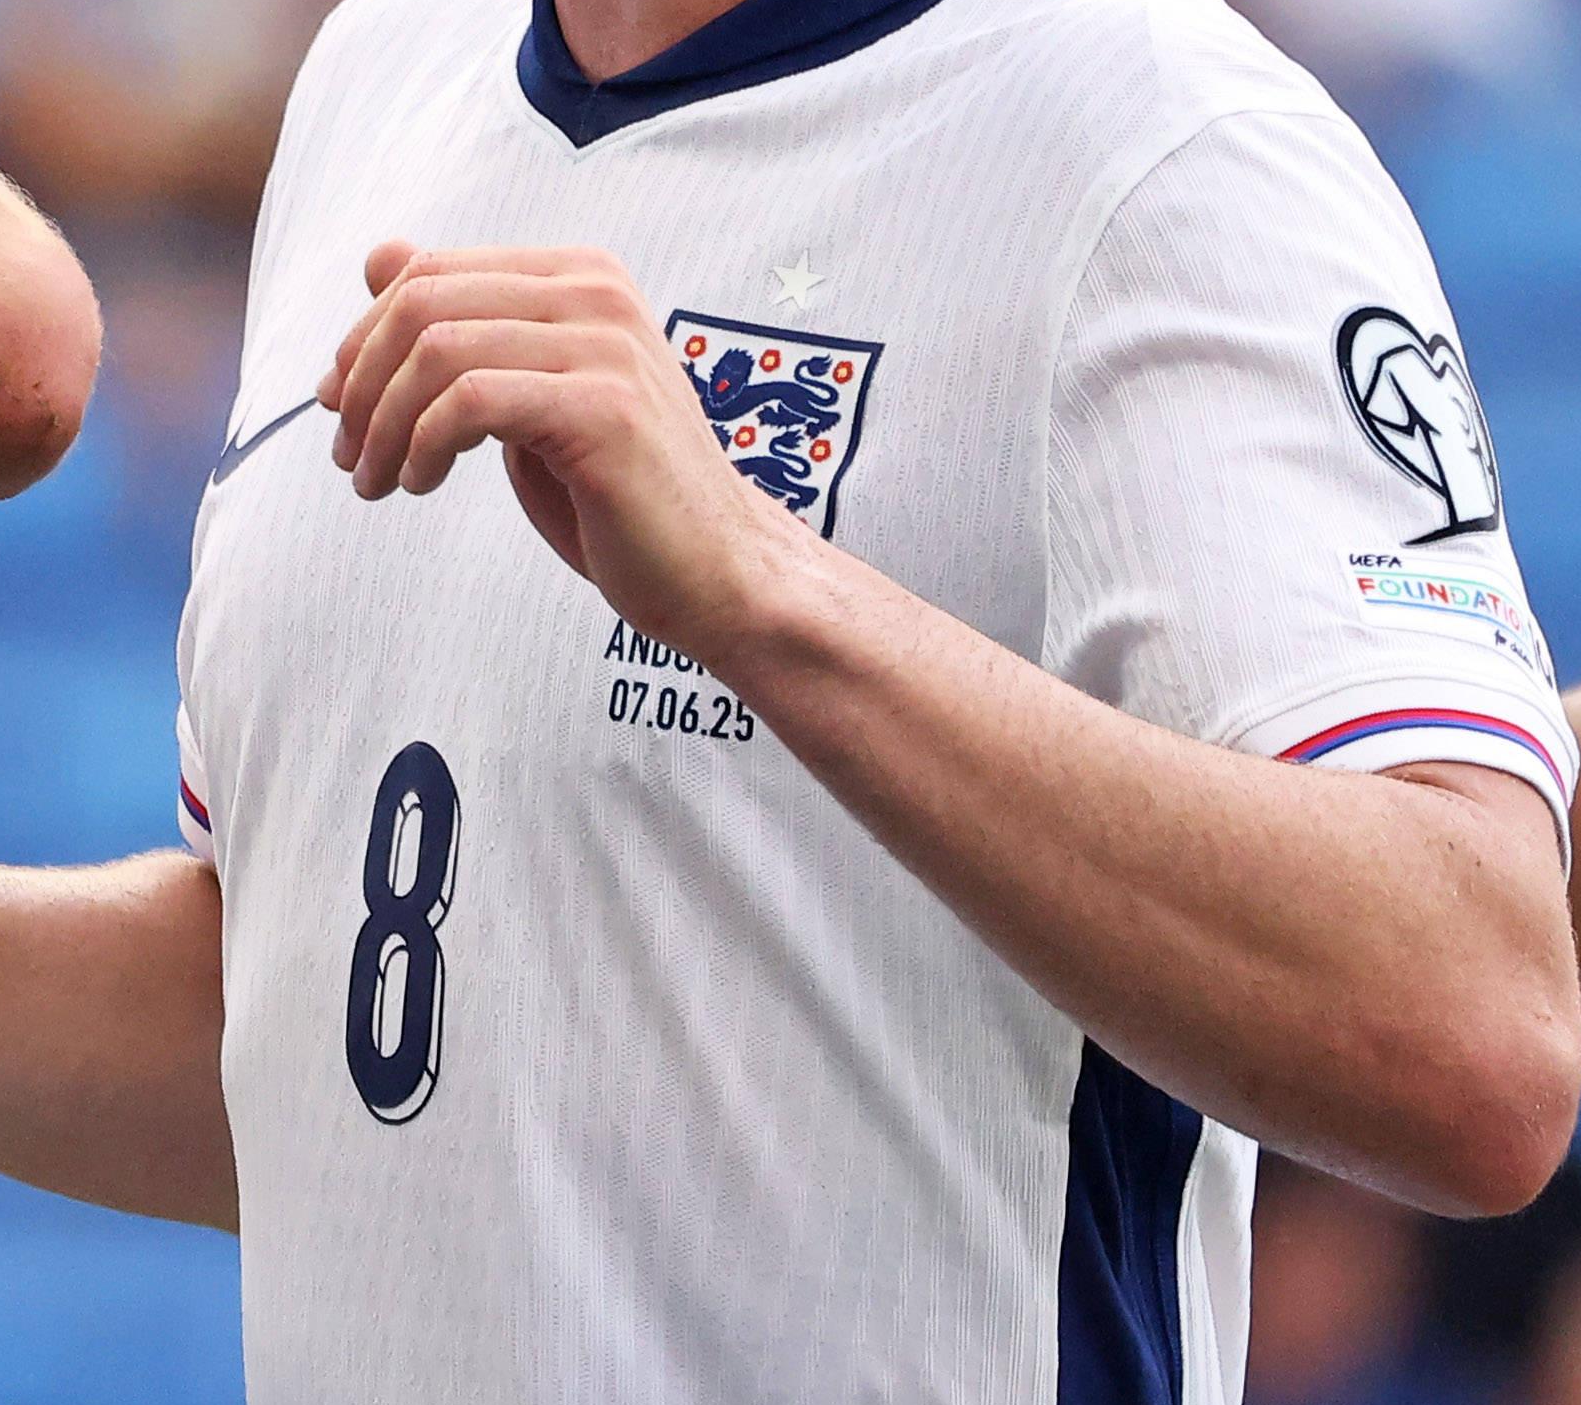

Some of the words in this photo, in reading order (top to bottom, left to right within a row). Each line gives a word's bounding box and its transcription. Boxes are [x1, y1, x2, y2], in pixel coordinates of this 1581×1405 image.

[1349, 554, 1402, 568] UEFA
[1357, 577, 1525, 634] FOUNDATIO
[608, 678, 754, 741] 07.06.25
[346, 740, 461, 1126] 8
